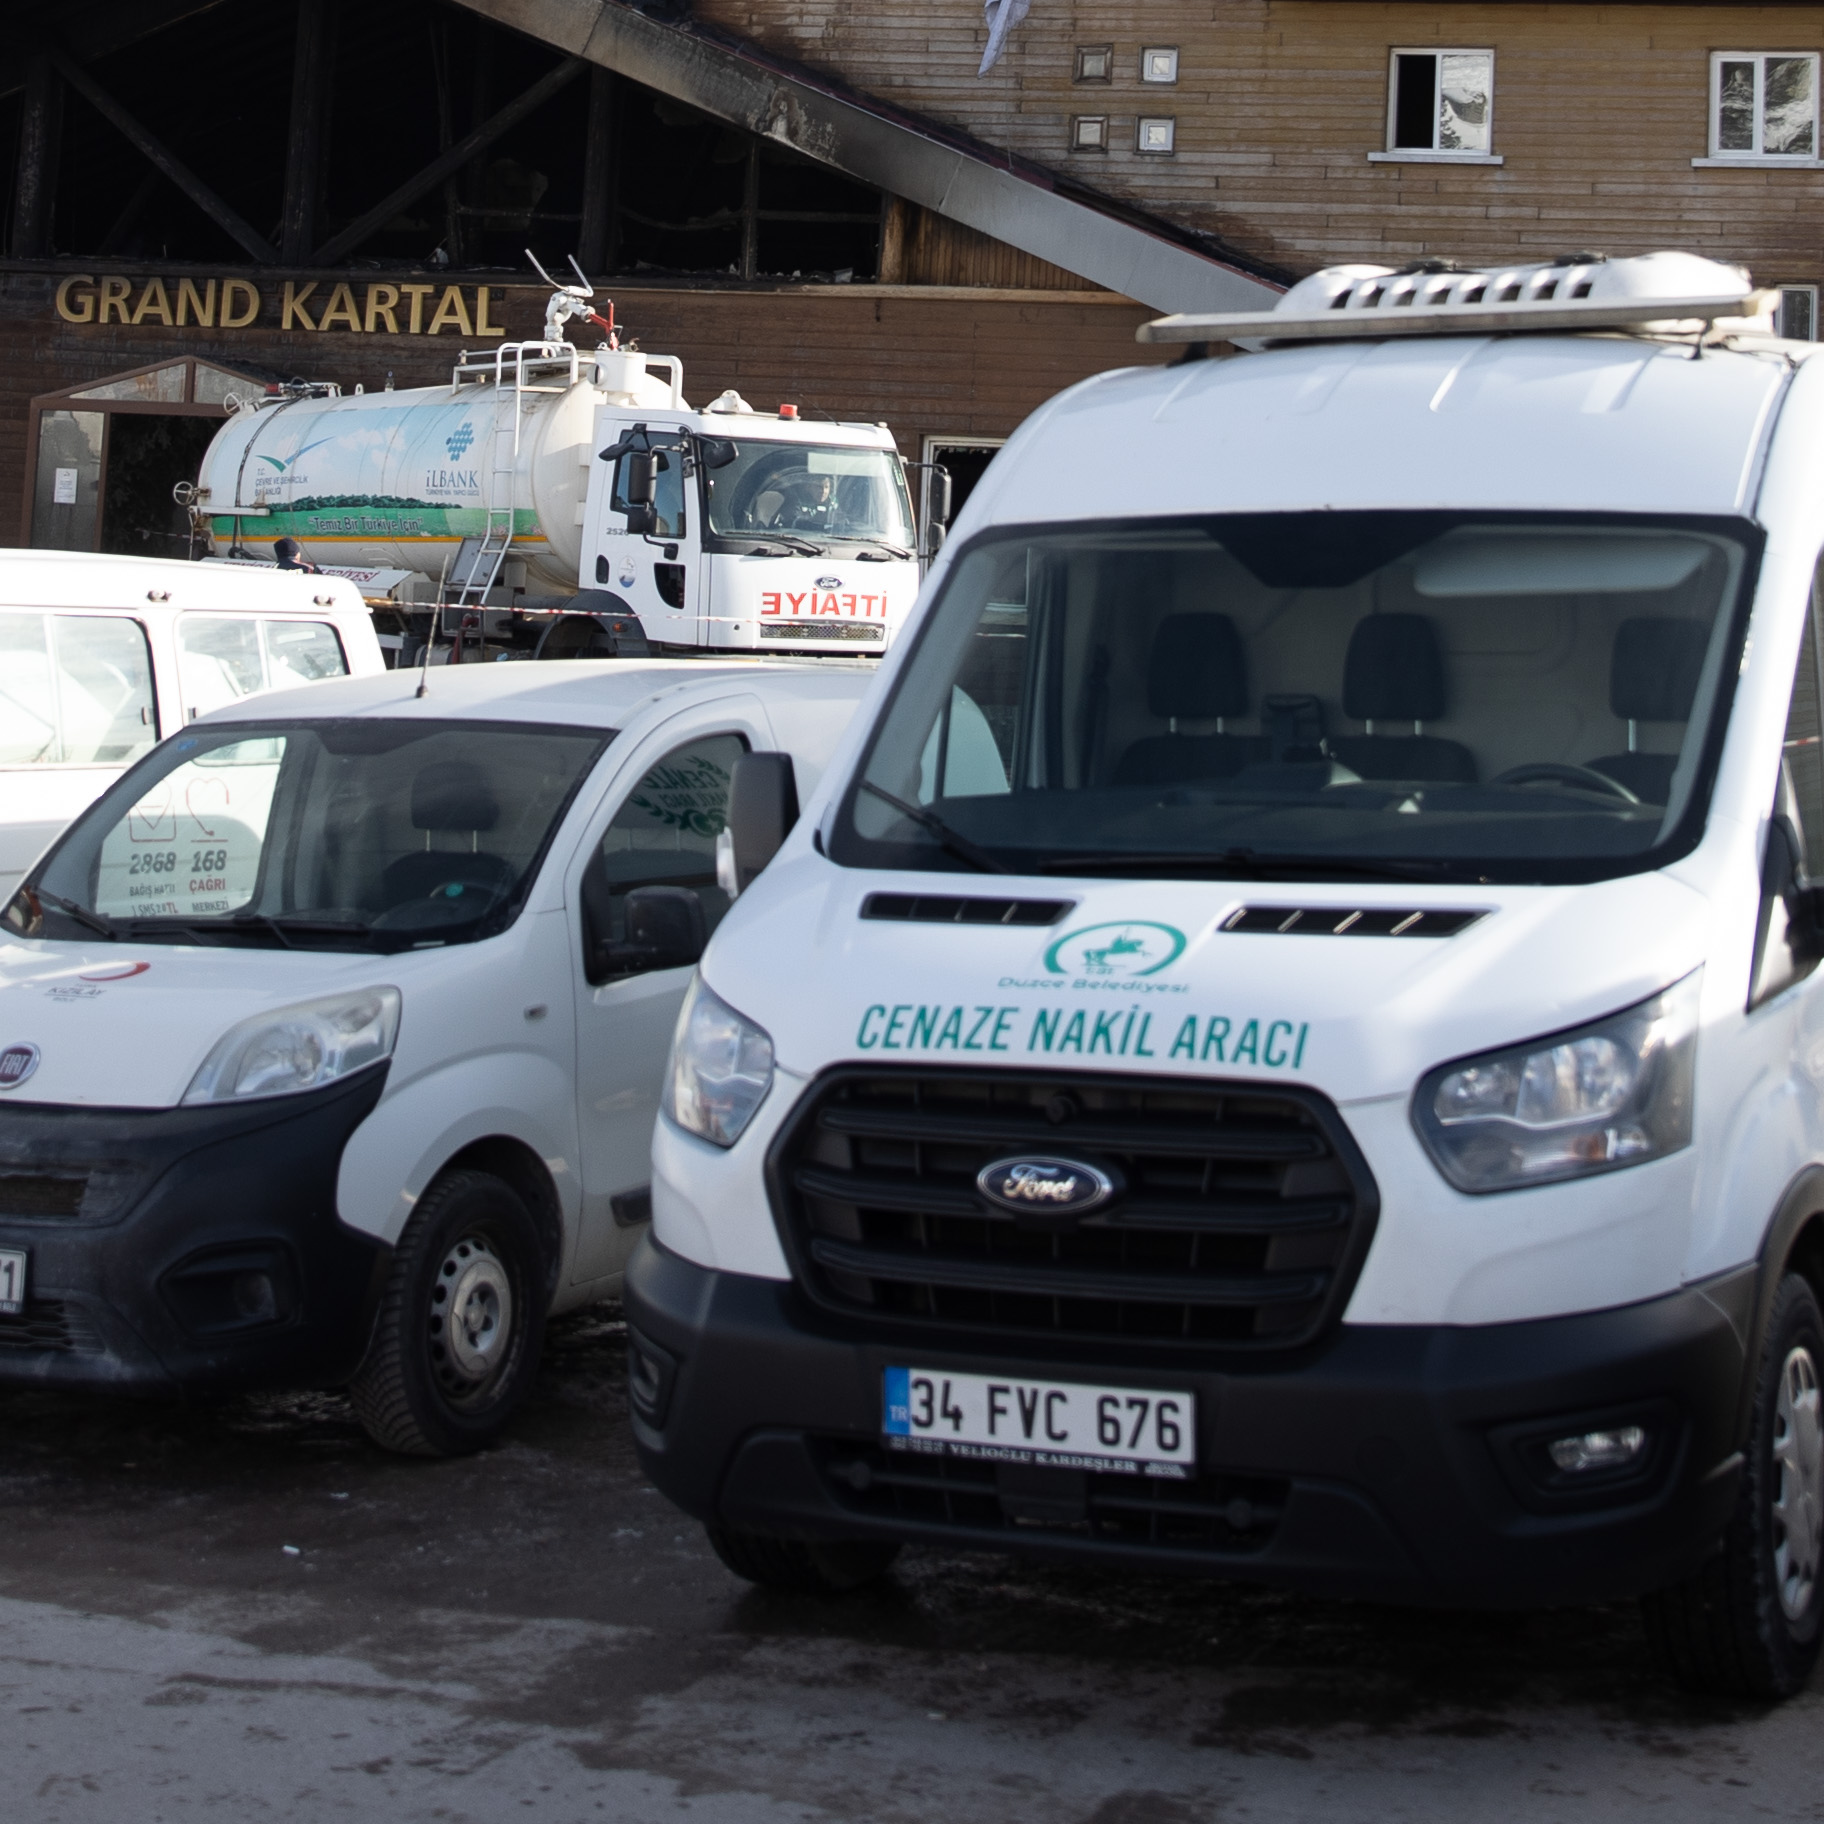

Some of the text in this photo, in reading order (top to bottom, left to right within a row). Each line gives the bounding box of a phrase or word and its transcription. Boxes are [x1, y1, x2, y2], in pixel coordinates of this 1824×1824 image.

[56, 275, 506, 337] GRAND KARTAL
[344, 517, 359, 530] Bir
[362, 515, 398, 534] Türkiye
[129, 849, 227, 875] 2868 168
[189, 874, 226, 895] ÇAĞRI
[1071, 976, 1190, 993] Belediyesi
[856, 1003, 1310, 1069] CENAZE NAKİL ARACI
[1002, 1162, 1078, 1202] Ford
[889, 1404, 908, 1422] TR
[910, 1376, 1182, 1454] 34 FVC 676
[1036, 1451, 1138, 1474] KARDEŞLER
